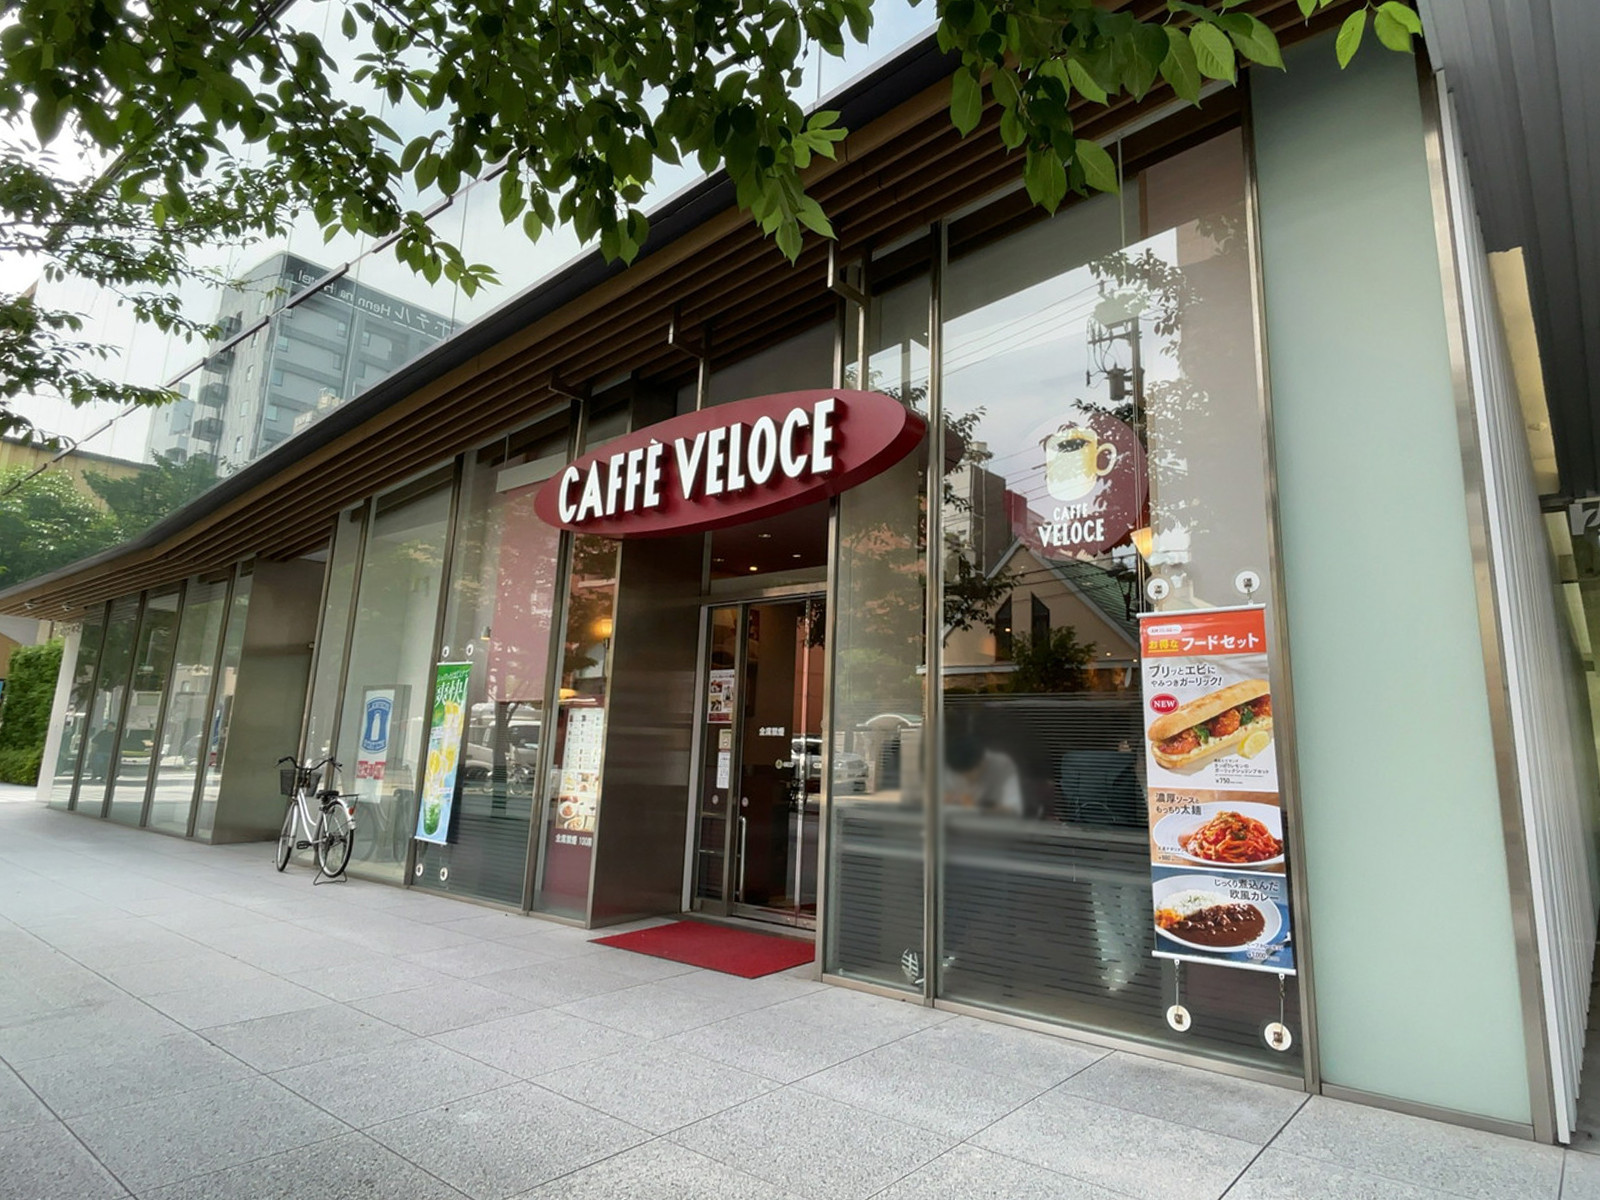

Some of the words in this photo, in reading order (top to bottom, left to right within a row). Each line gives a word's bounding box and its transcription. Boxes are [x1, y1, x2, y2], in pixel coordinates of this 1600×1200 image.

[558, 438, 664, 524] CAFFÈ
[674, 397, 836, 500] VELOCE
[1038, 518, 1105, 547] VELOCE
[1148, 639, 1179, 650] お得な
[1181, 632, 1260, 651] フードセット
[1154, 699, 1176, 708] NEW
[1155, 792, 1200, 804] 濃厚ソースと
[1214, 878, 1279, 892] じっくり煮込んだ
[1230, 889, 1280, 902] 欧風カレー
